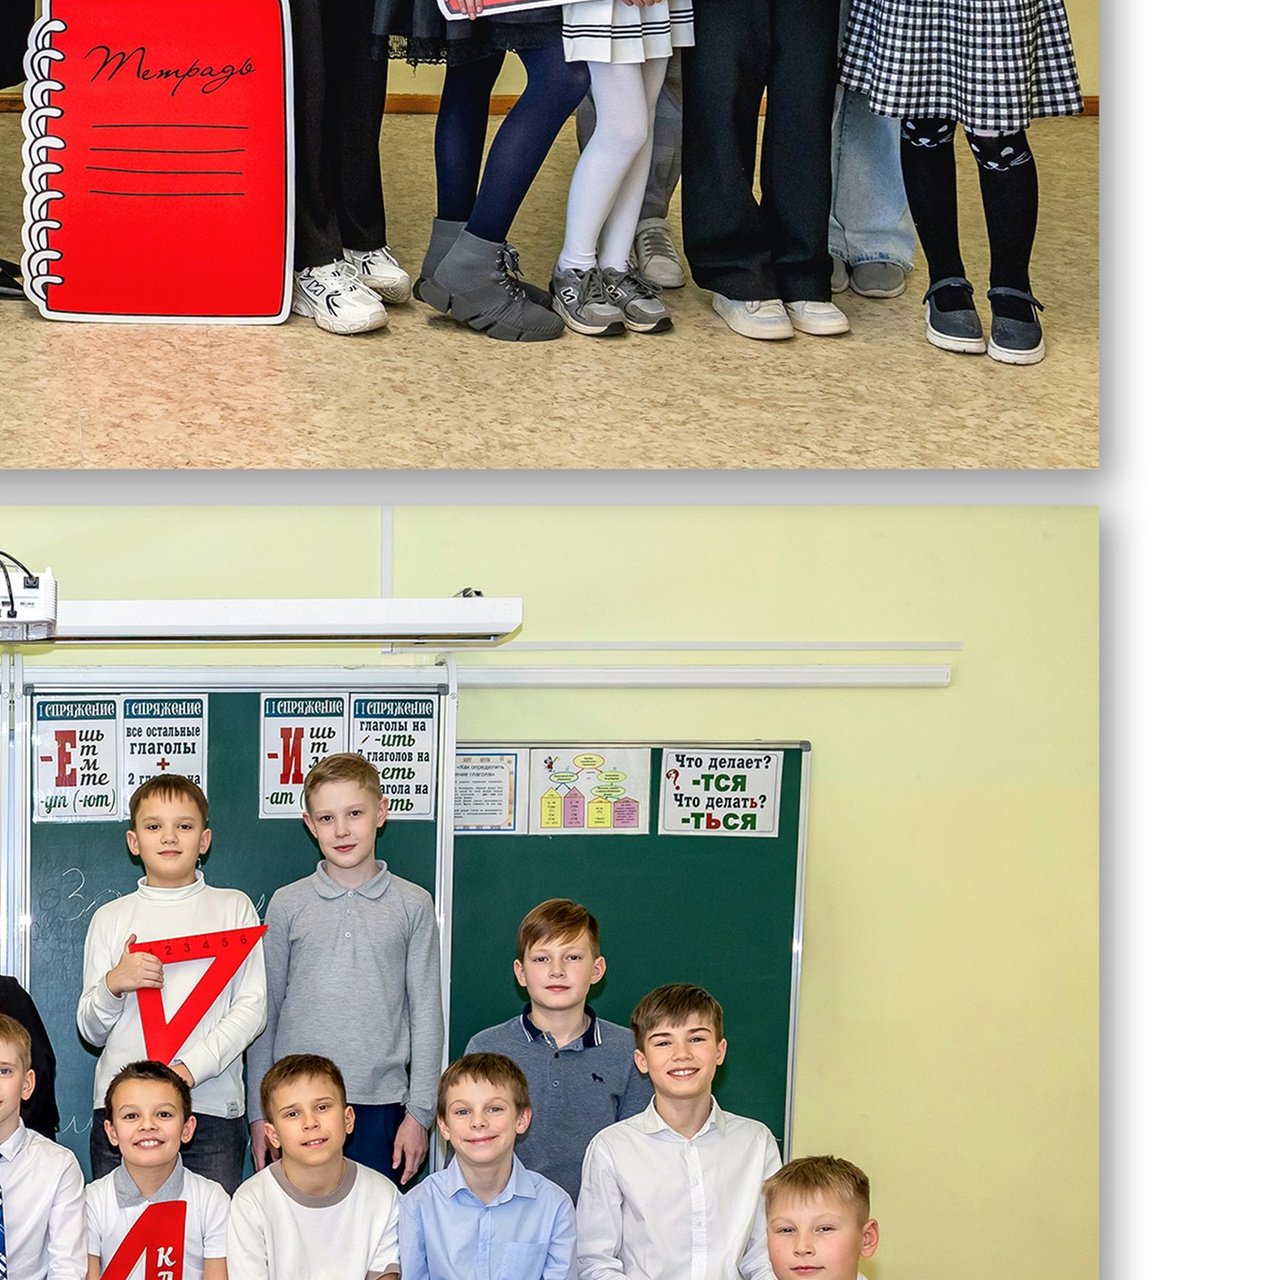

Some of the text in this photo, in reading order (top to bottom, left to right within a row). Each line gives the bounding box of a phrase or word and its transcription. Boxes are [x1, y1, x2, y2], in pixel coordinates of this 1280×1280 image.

[84, 45, 256, 97] Тетрадь
[44, 702, 115, 718] СПРЯЖЕНИЕ
[131, 701, 202, 718] СПРЯЖЕНИЕ
[277, 700, 343, 715] СПРЯЖЕНИЕ
[366, 701, 433, 717] СПРЯЖЕНИЕ
[126, 726, 201, 738] все остальные
[359, 721, 426, 732] глаголы на
[129, 742, 196, 755] глаголы
[367, 751, 430, 762] глаголов на
[675, 754, 771, 770] Что делает?
[128, 773, 135, 786] 2
[381, 784, 428, 795] агола на
[673, 793, 767, 810] Что делать?
[165, 935, 247, 956] 2 3 4 5 6
